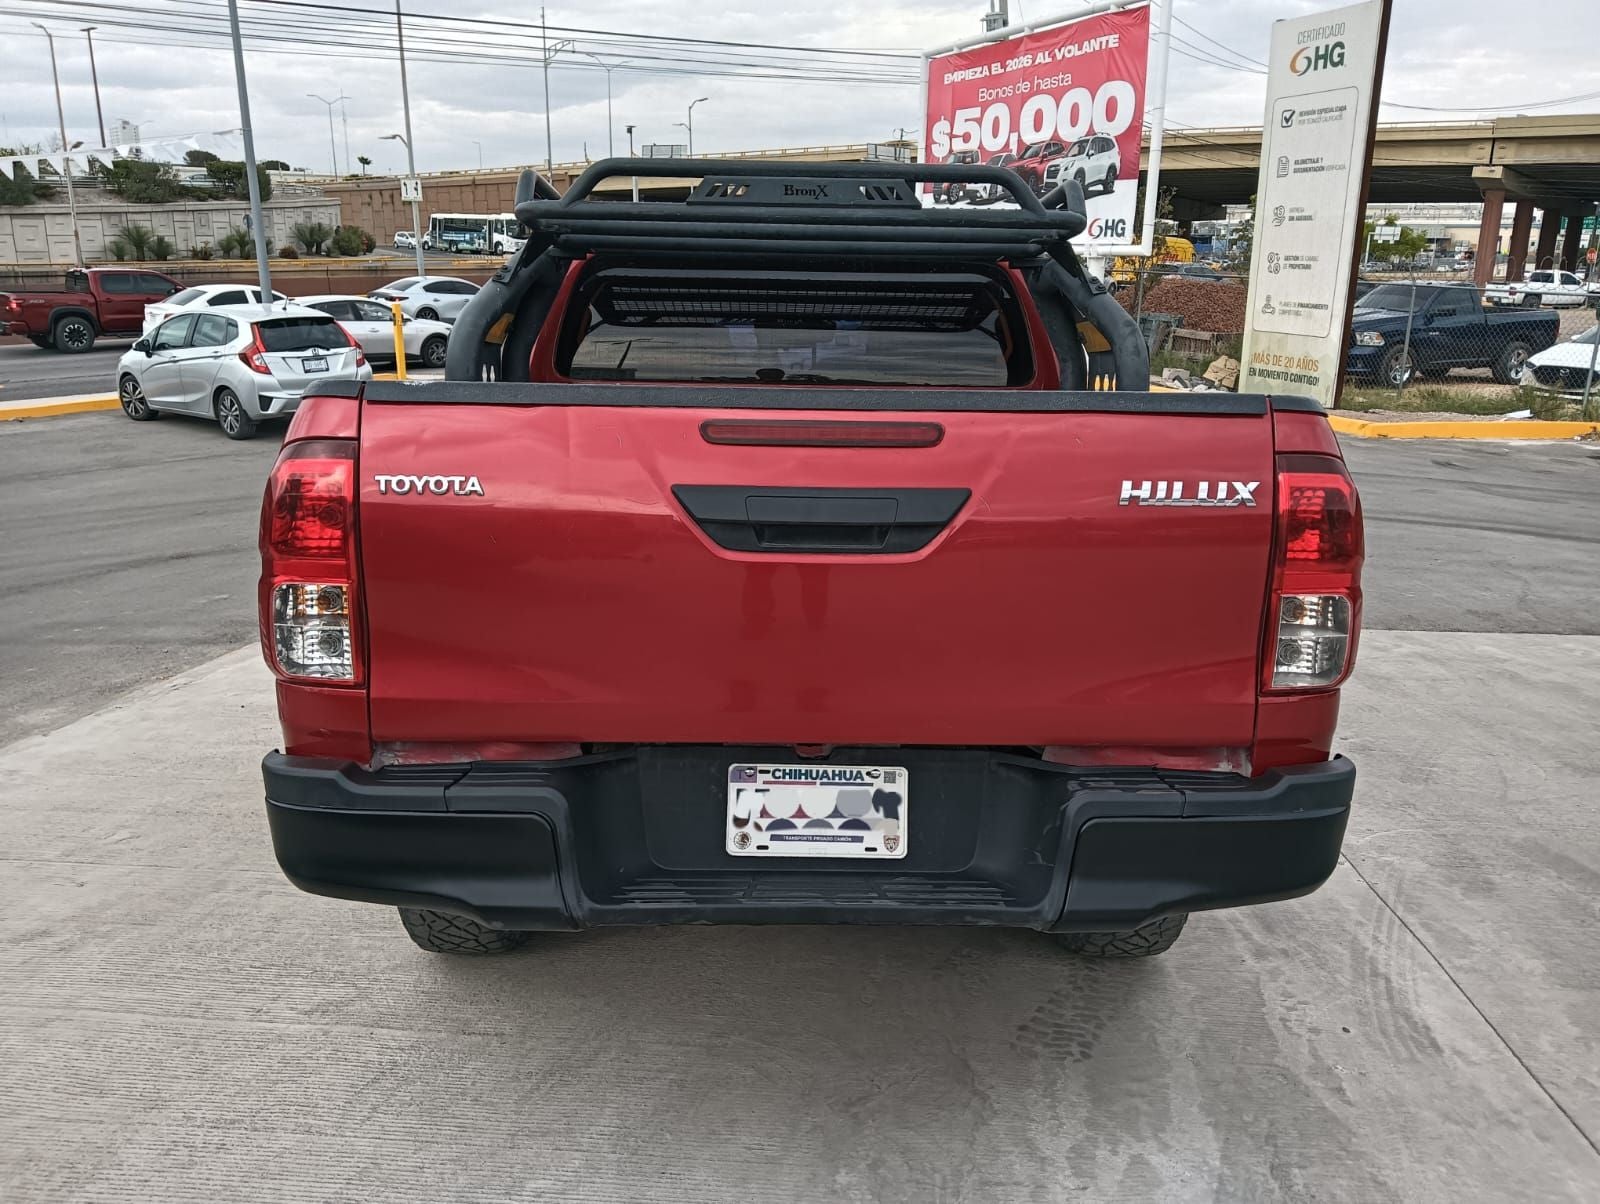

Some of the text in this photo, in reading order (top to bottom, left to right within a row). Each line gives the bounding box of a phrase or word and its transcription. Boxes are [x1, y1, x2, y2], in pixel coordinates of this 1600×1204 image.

[1297, 22, 1346, 45] CERTIFICADO
[944, 34, 1120, 86] EMPIEZA EL 2026 AL VOLANTE
[1313, 41, 1346, 71] HG
[978, 71, 1072, 103] Bonos de hasta
[931, 80, 1136, 163] $50,000
[783, 184, 829, 200] BronX
[1104, 218, 1126, 238] HG
[1272, 355, 1283, 366] DE
[1284, 356, 1295, 368] 20
[1296, 355, 1319, 372] AÑOS
[1248, 367, 1320, 386] EN MOVIENTO CONTIGO!
[374, 475, 484, 496] TOYOTA
[1119, 480, 1260, 507] HILUX
[772, 768, 865, 782] CHIHUAHUA
